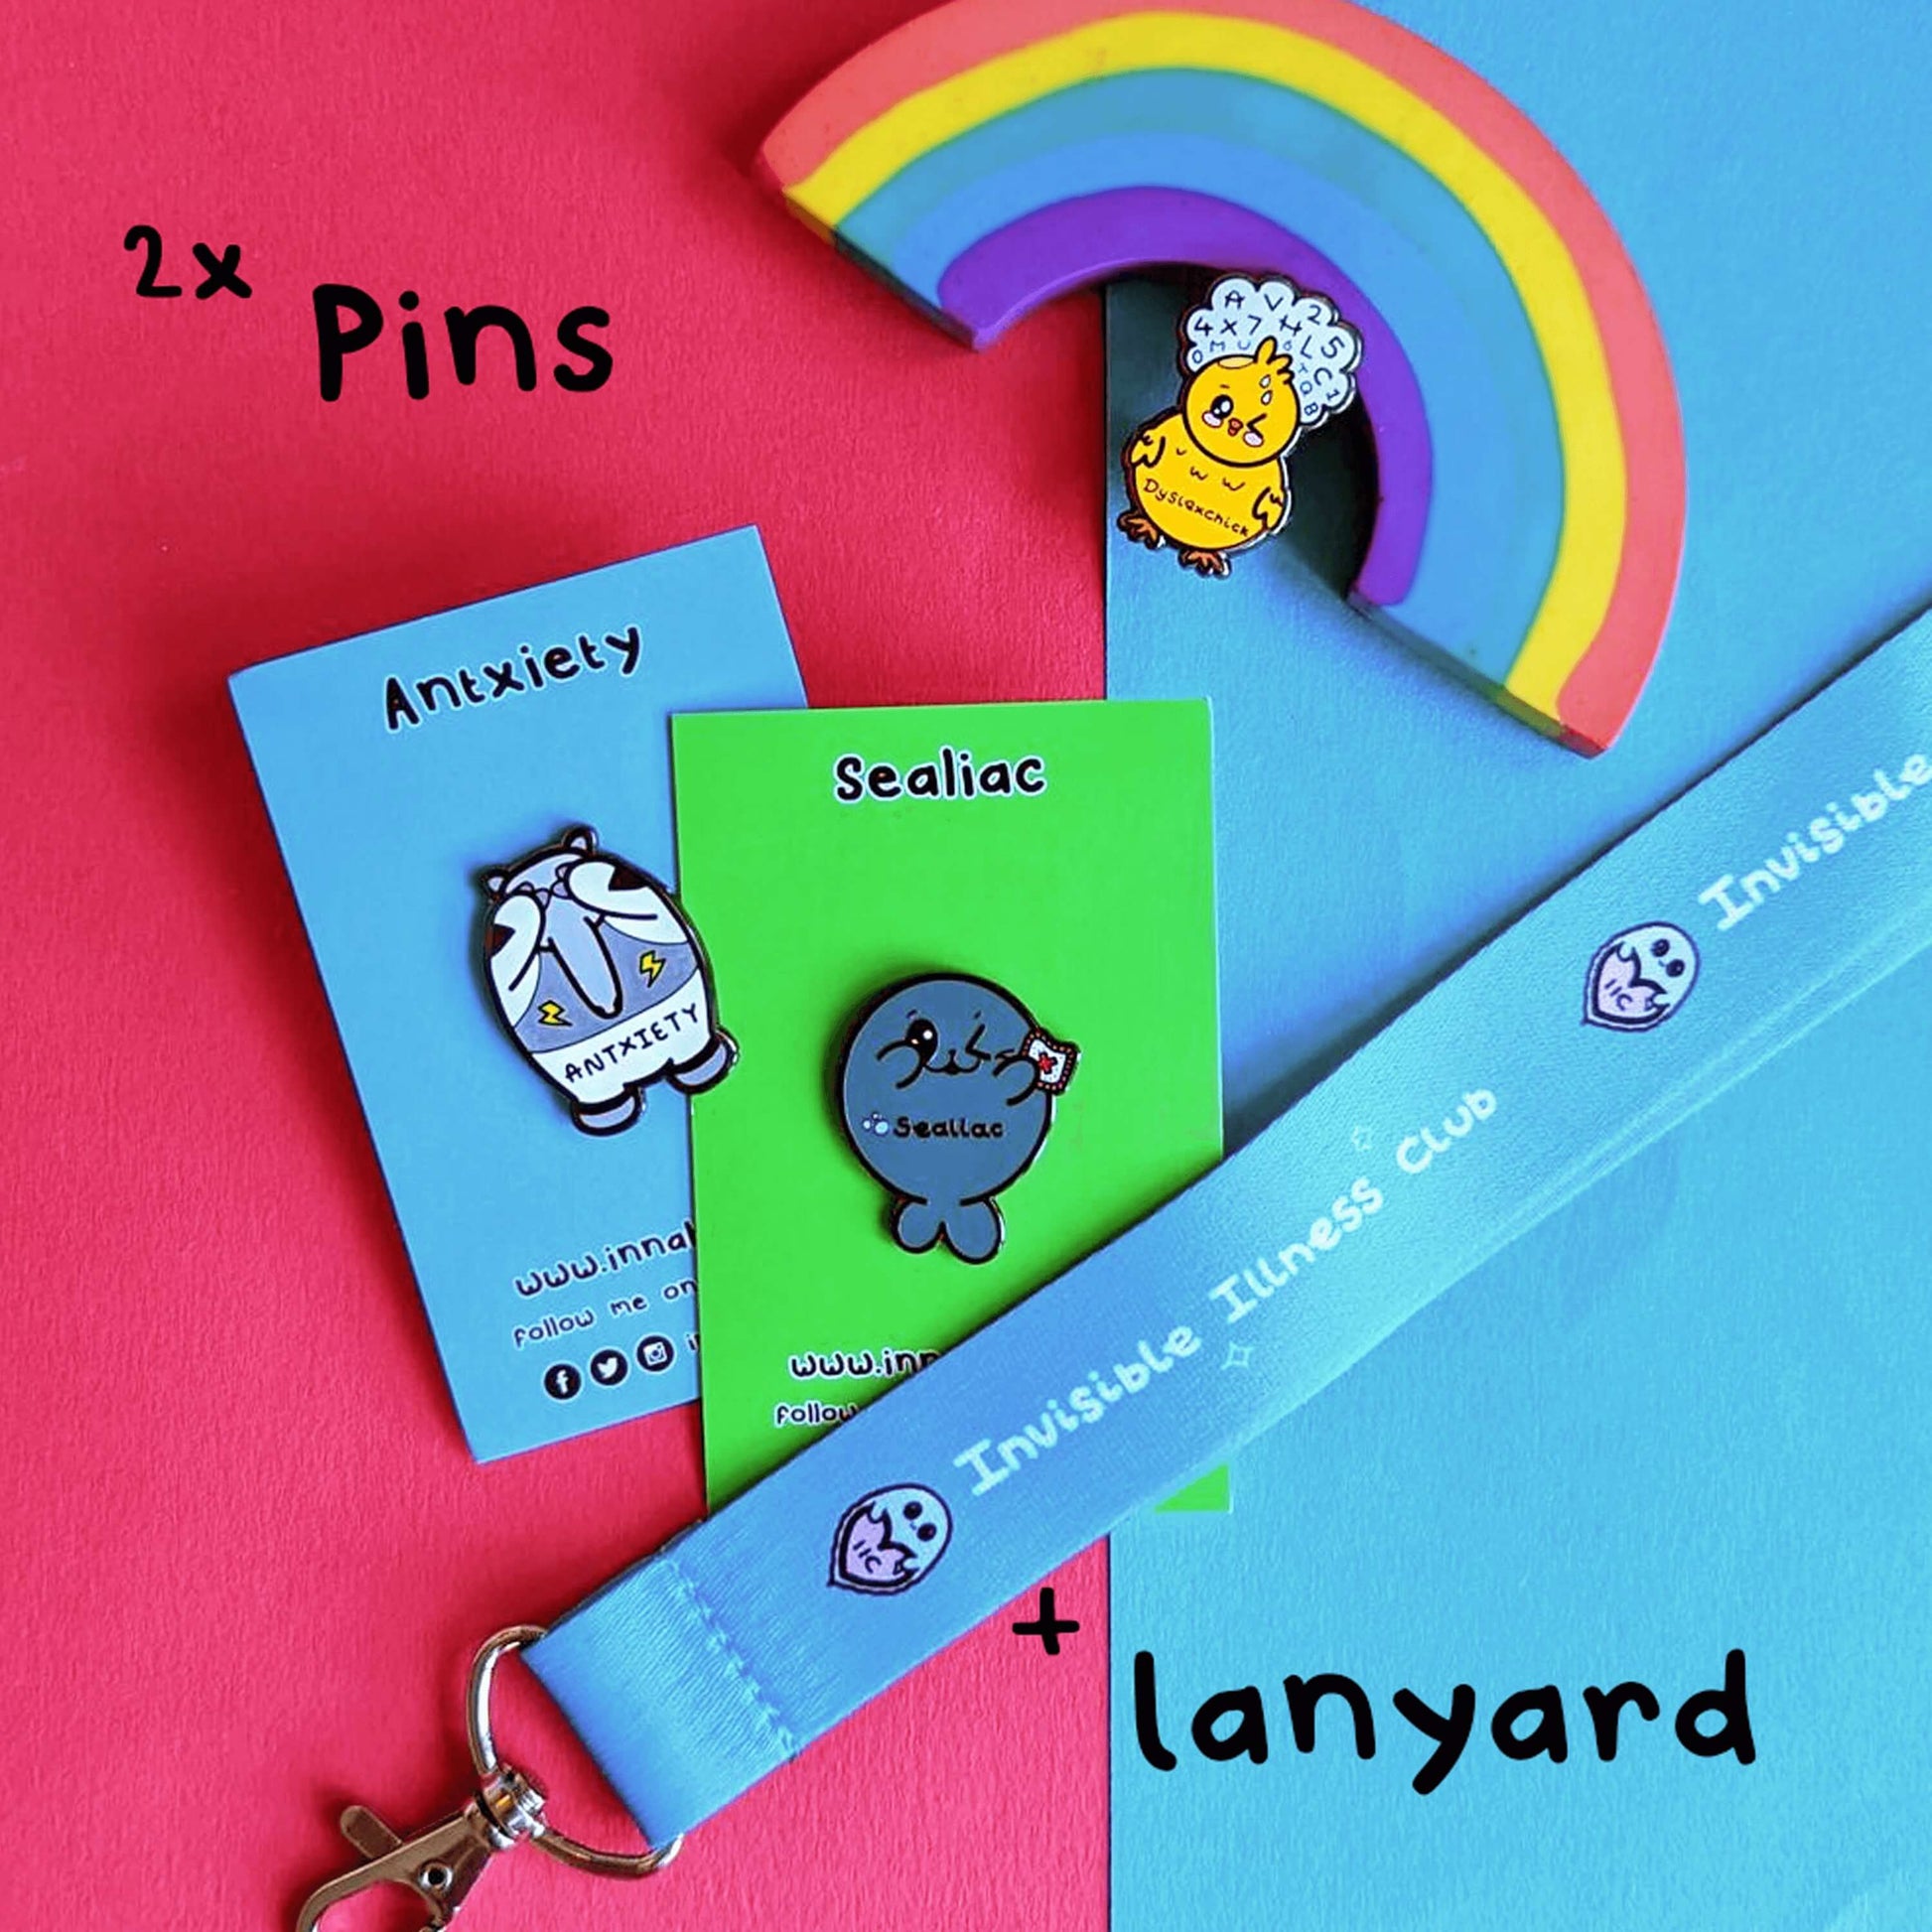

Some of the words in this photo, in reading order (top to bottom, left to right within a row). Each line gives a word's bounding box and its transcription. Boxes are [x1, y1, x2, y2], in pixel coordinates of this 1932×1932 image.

[385, 626, 640, 730] Antxiety
[836, 748, 1045, 801] Sealiac
[1697, 754, 1932, 930] Invisible
[564, 1002, 699, 1083] ANTXIETY
[513, 1309, 594, 1348] follow
[609, 1297, 647, 1315] me
[953, 1325, 1202, 1496] Invisible
[1207, 1175, 1385, 1324] Illness
[1395, 1088, 1498, 1173] Club
